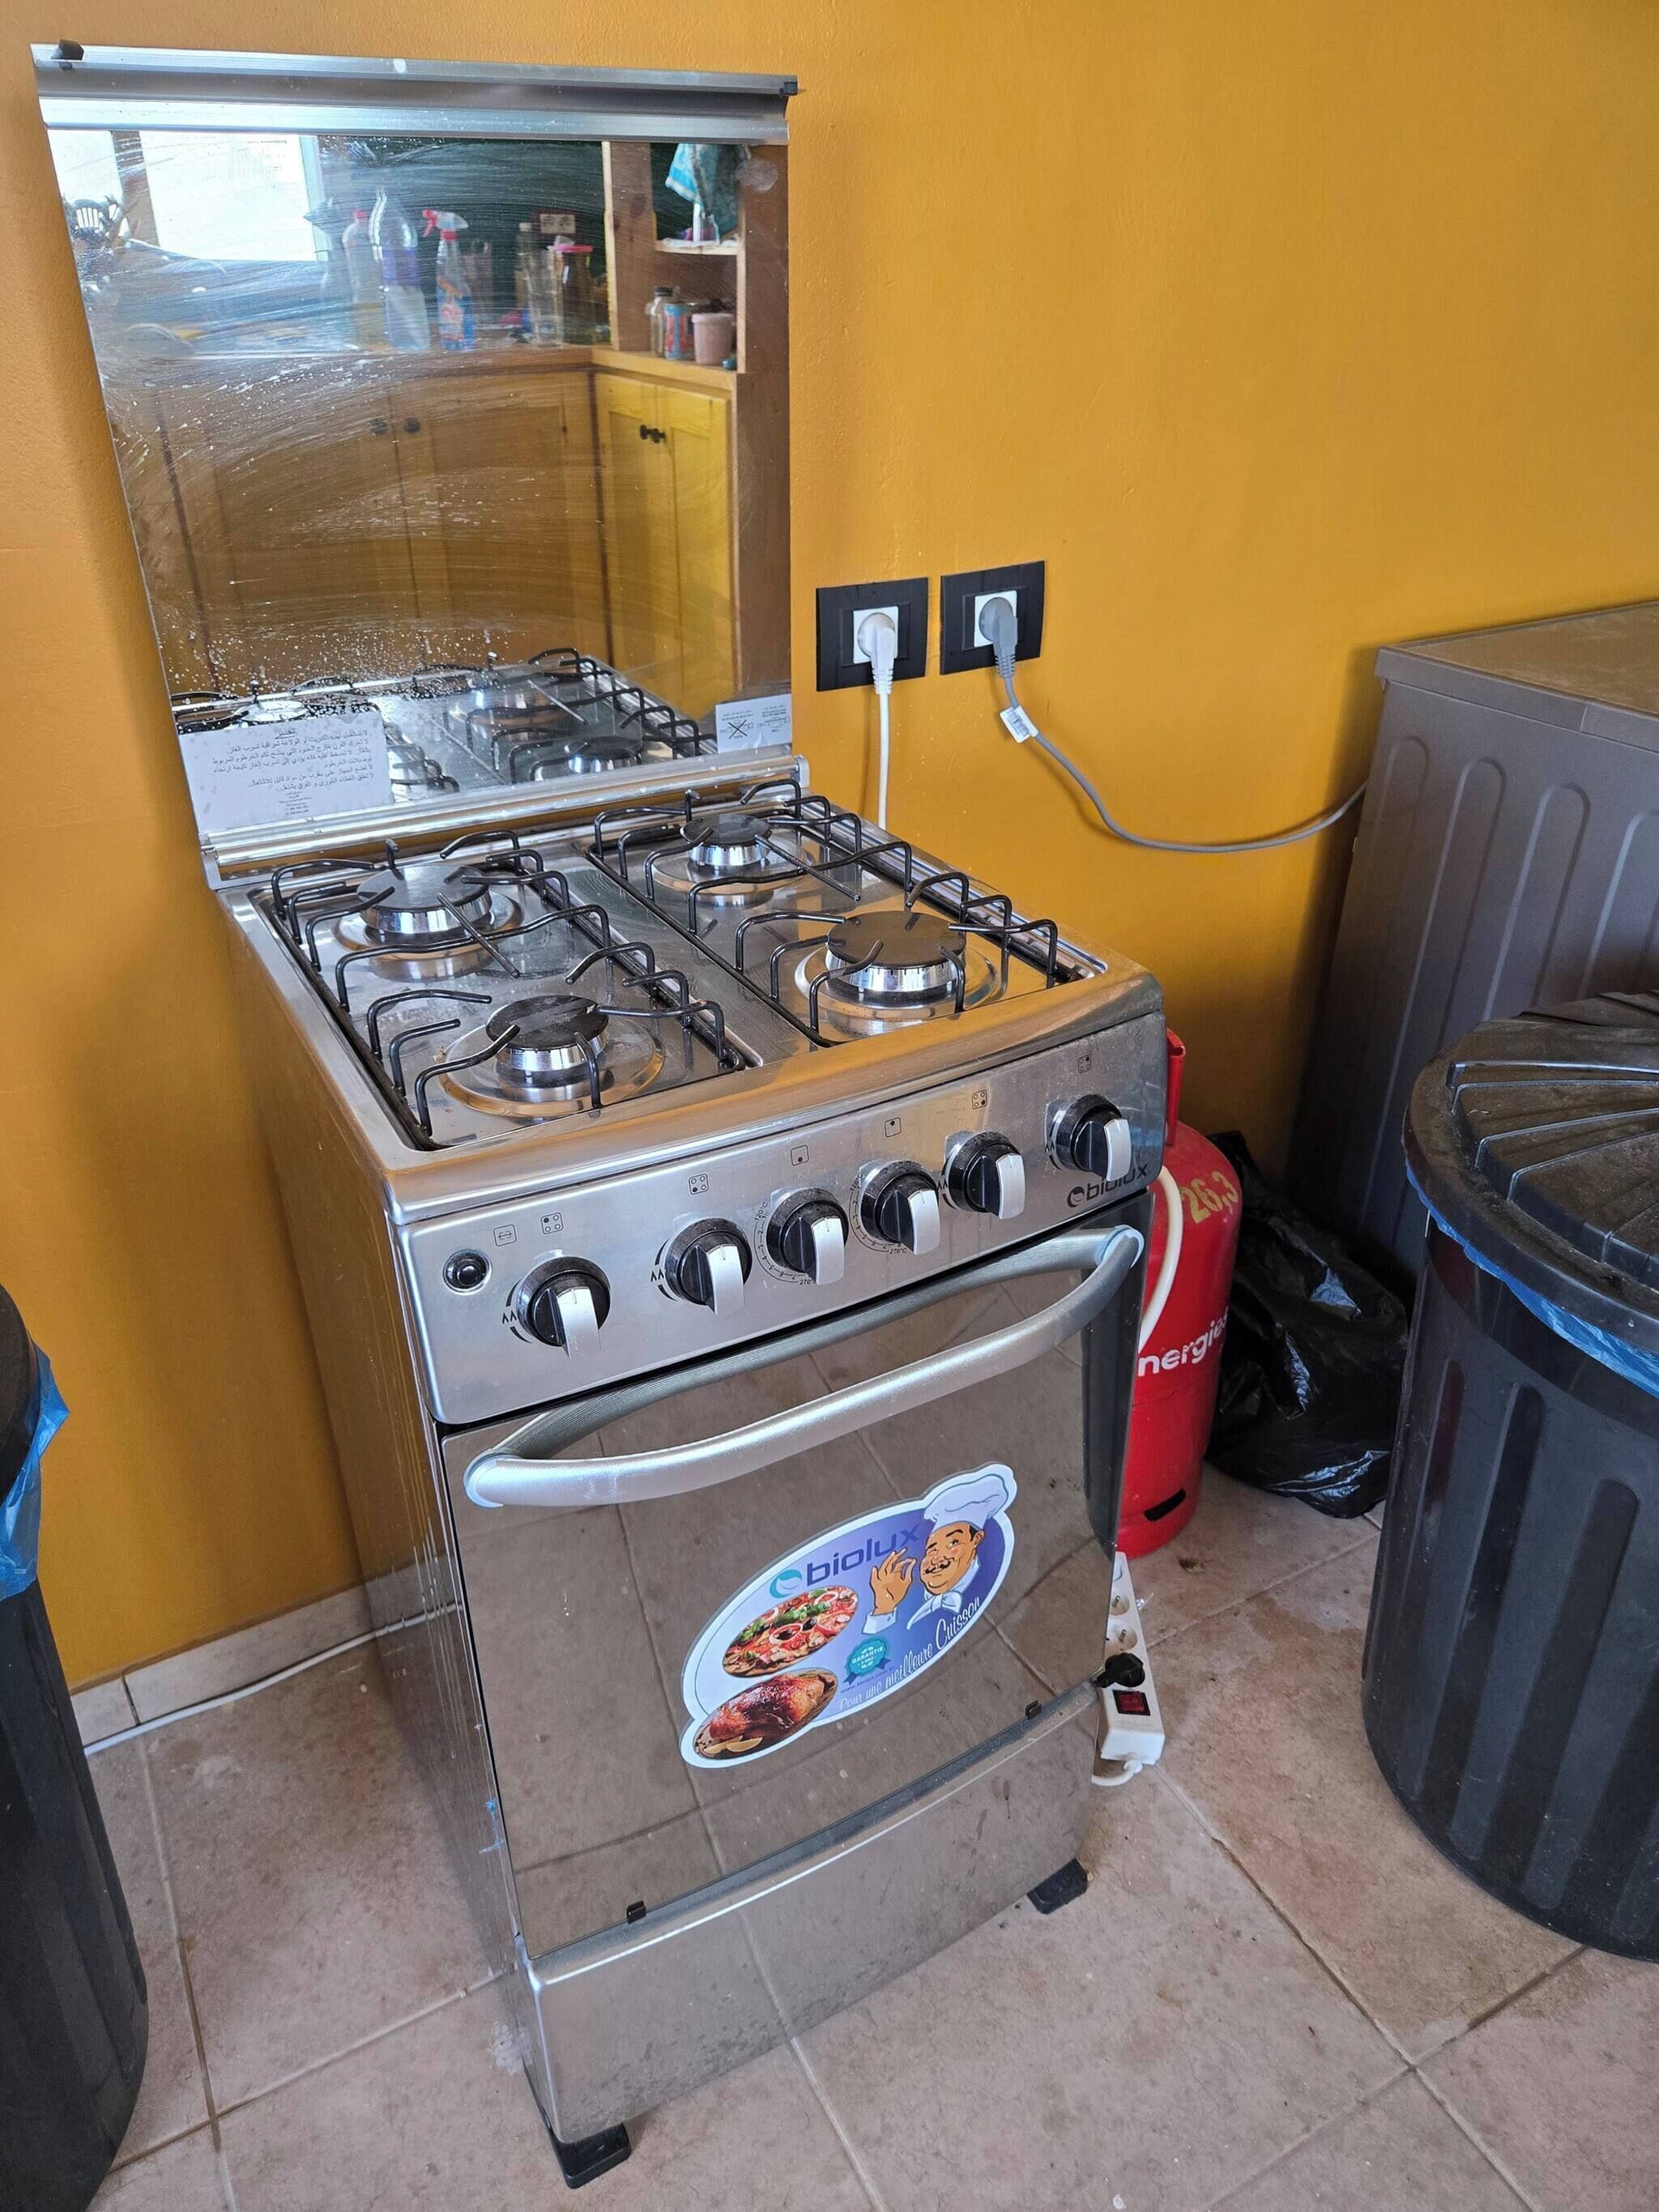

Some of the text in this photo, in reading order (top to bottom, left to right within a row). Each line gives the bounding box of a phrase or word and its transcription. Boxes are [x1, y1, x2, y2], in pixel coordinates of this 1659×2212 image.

[807, 1524, 922, 1587] biolux
[840, 1596, 980, 1710] Pour une meilleure Cuisson
